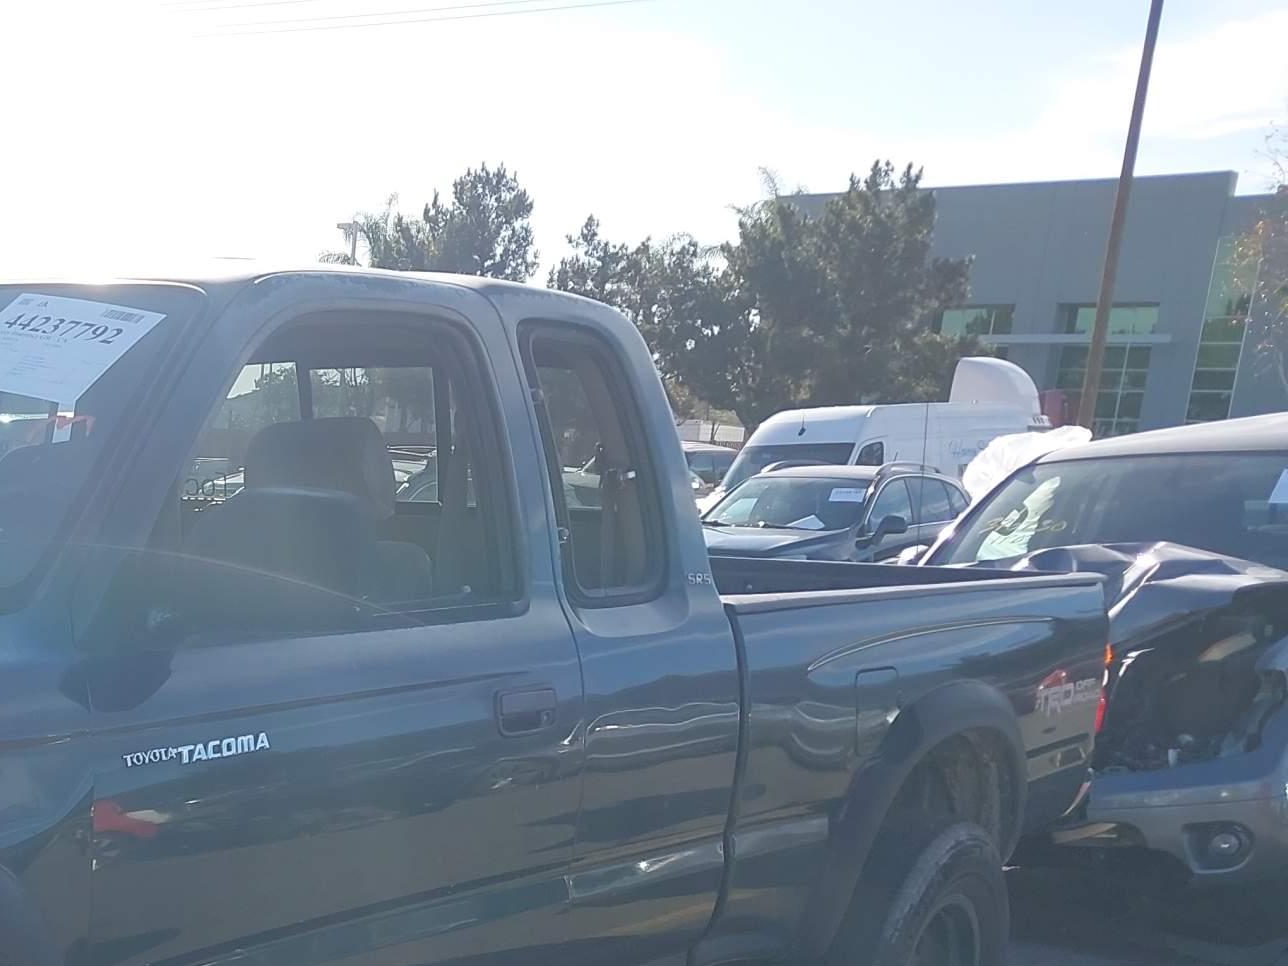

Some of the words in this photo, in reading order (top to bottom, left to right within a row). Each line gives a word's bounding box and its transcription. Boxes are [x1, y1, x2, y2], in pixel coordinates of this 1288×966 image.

[4, 313, 123, 344] 44237792
[687, 573, 711, 585] SR5
[123, 747, 176, 767] TOYOTA
[177, 732, 270, 764] TACOMA
